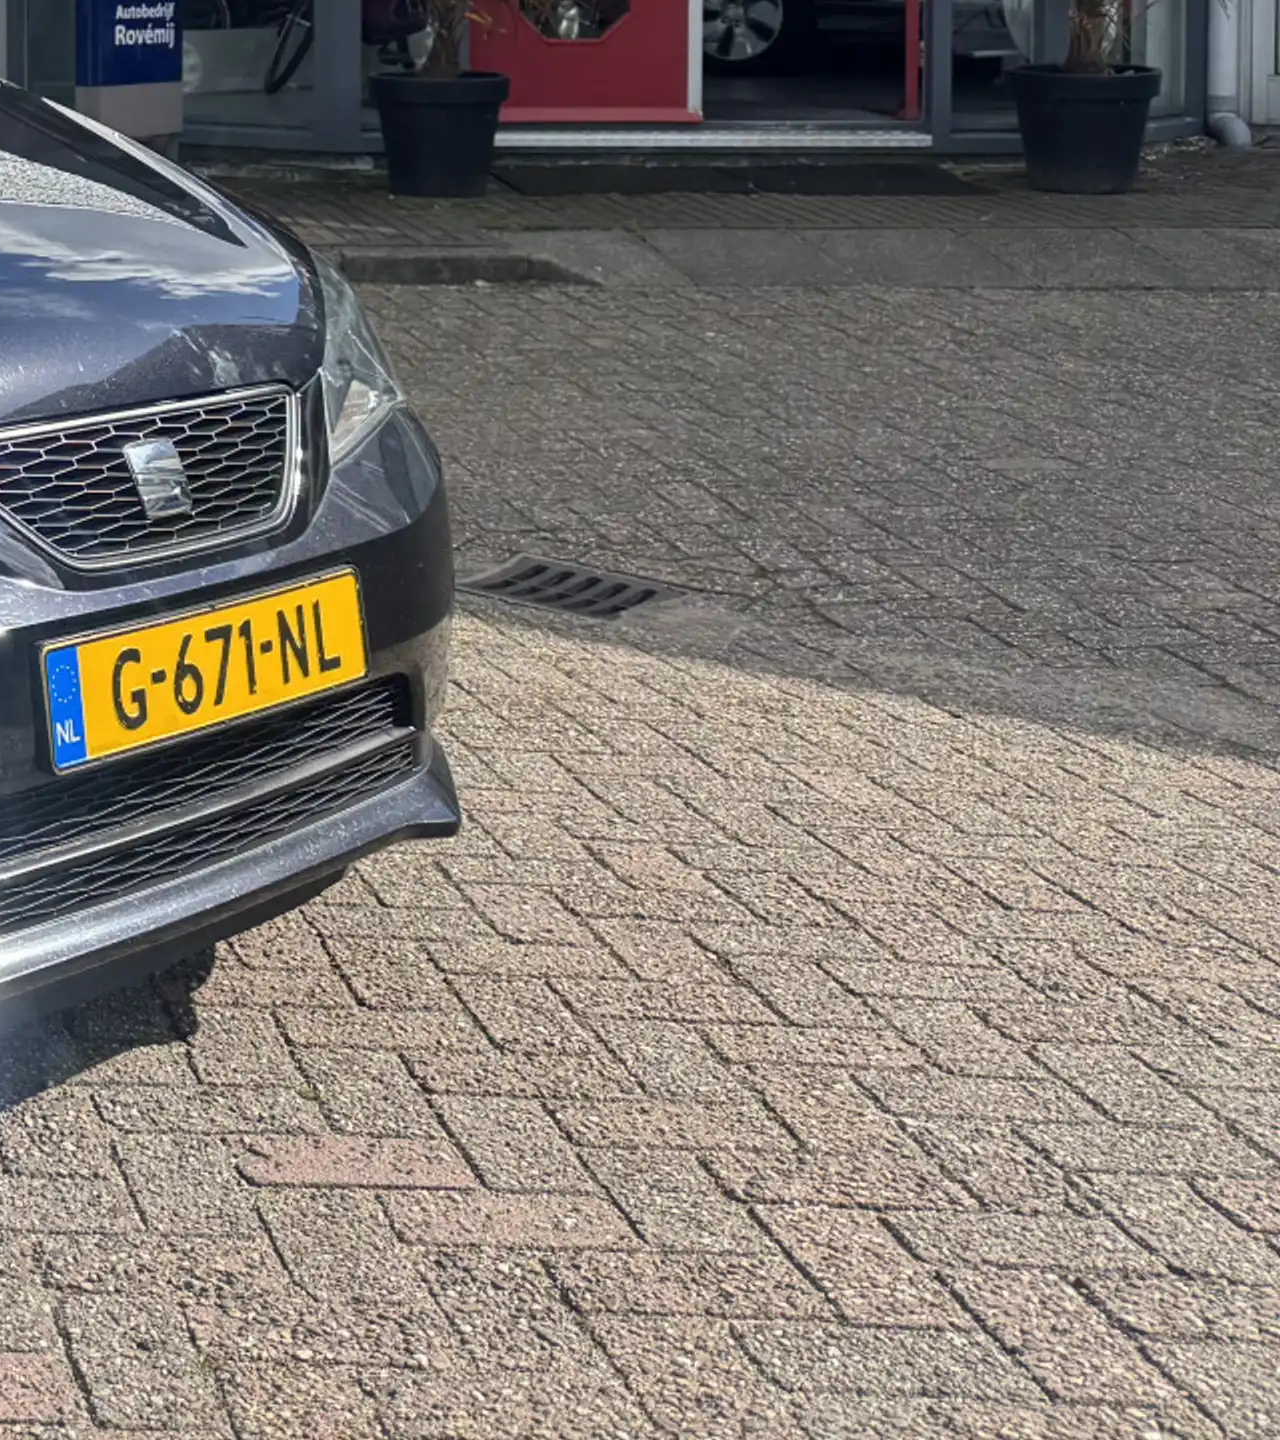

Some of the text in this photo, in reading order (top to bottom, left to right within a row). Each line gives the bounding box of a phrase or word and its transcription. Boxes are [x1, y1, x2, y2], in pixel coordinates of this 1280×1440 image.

[116, 2, 175, 20] Autobedrijf
[115, 22, 175, 48] Rovémij
[112, 599, 341, 731] G-671-NL
[56, 721, 81, 745] NL
